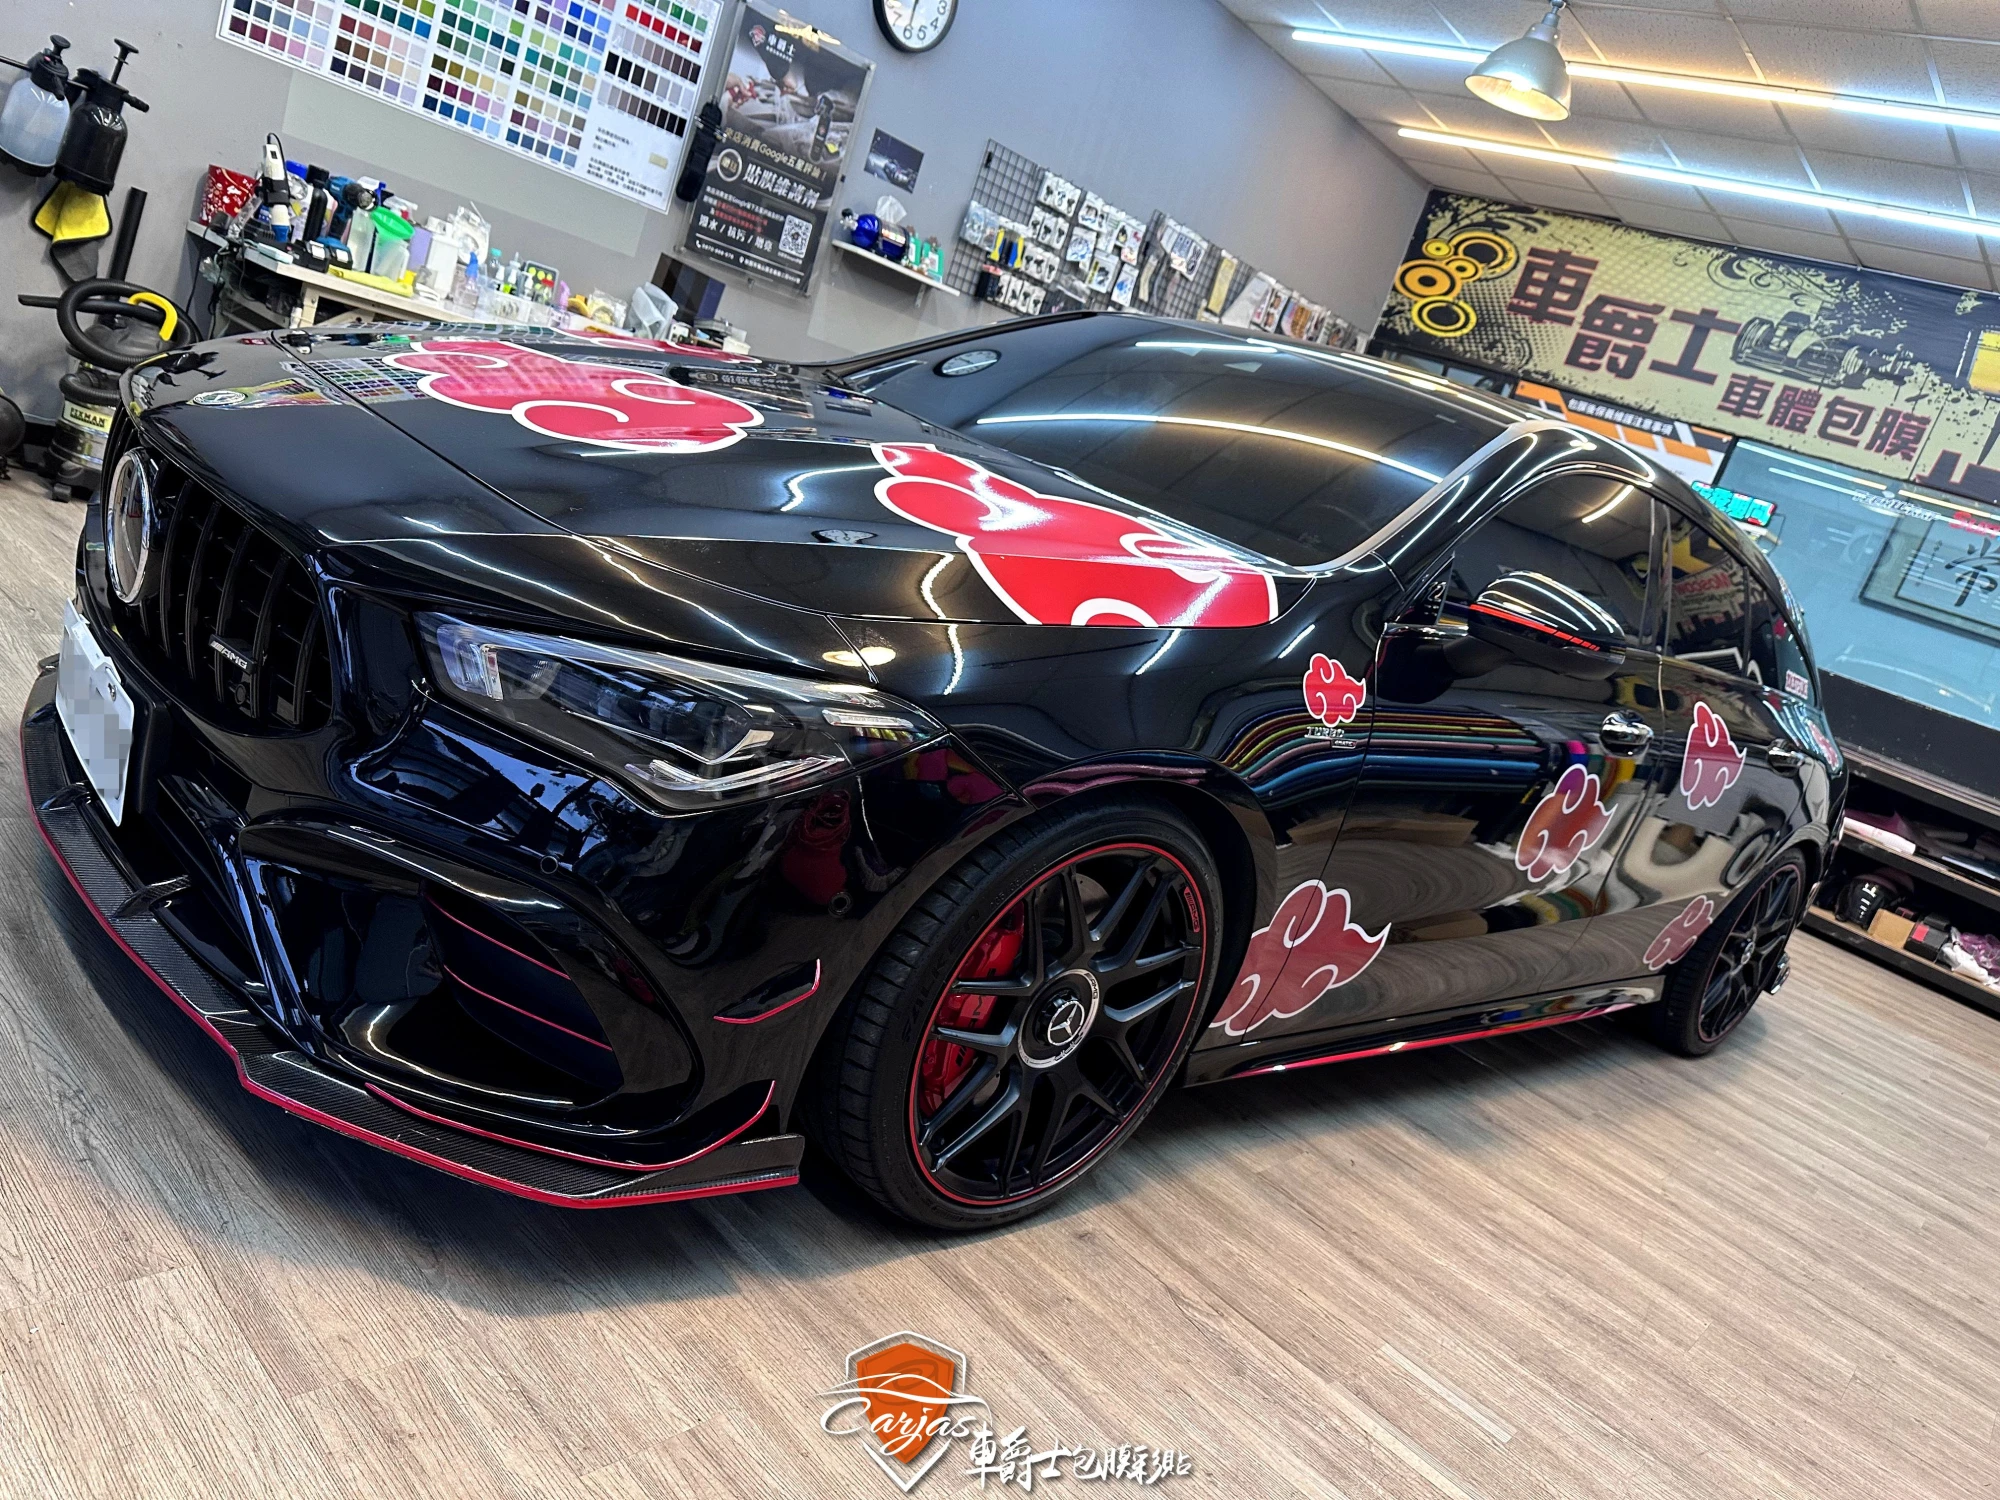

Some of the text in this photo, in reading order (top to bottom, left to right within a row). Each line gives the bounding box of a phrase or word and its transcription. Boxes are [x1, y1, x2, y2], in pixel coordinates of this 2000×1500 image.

[902, 23, 914, 40] 6
[917, 24, 928, 41] 5
[930, 16, 939, 32] 4
[1506, 246, 1932, 463] 車爵士 車體包膜
[221, 647, 248, 670] AMG
[1306, 726, 1345, 738] TURBO
